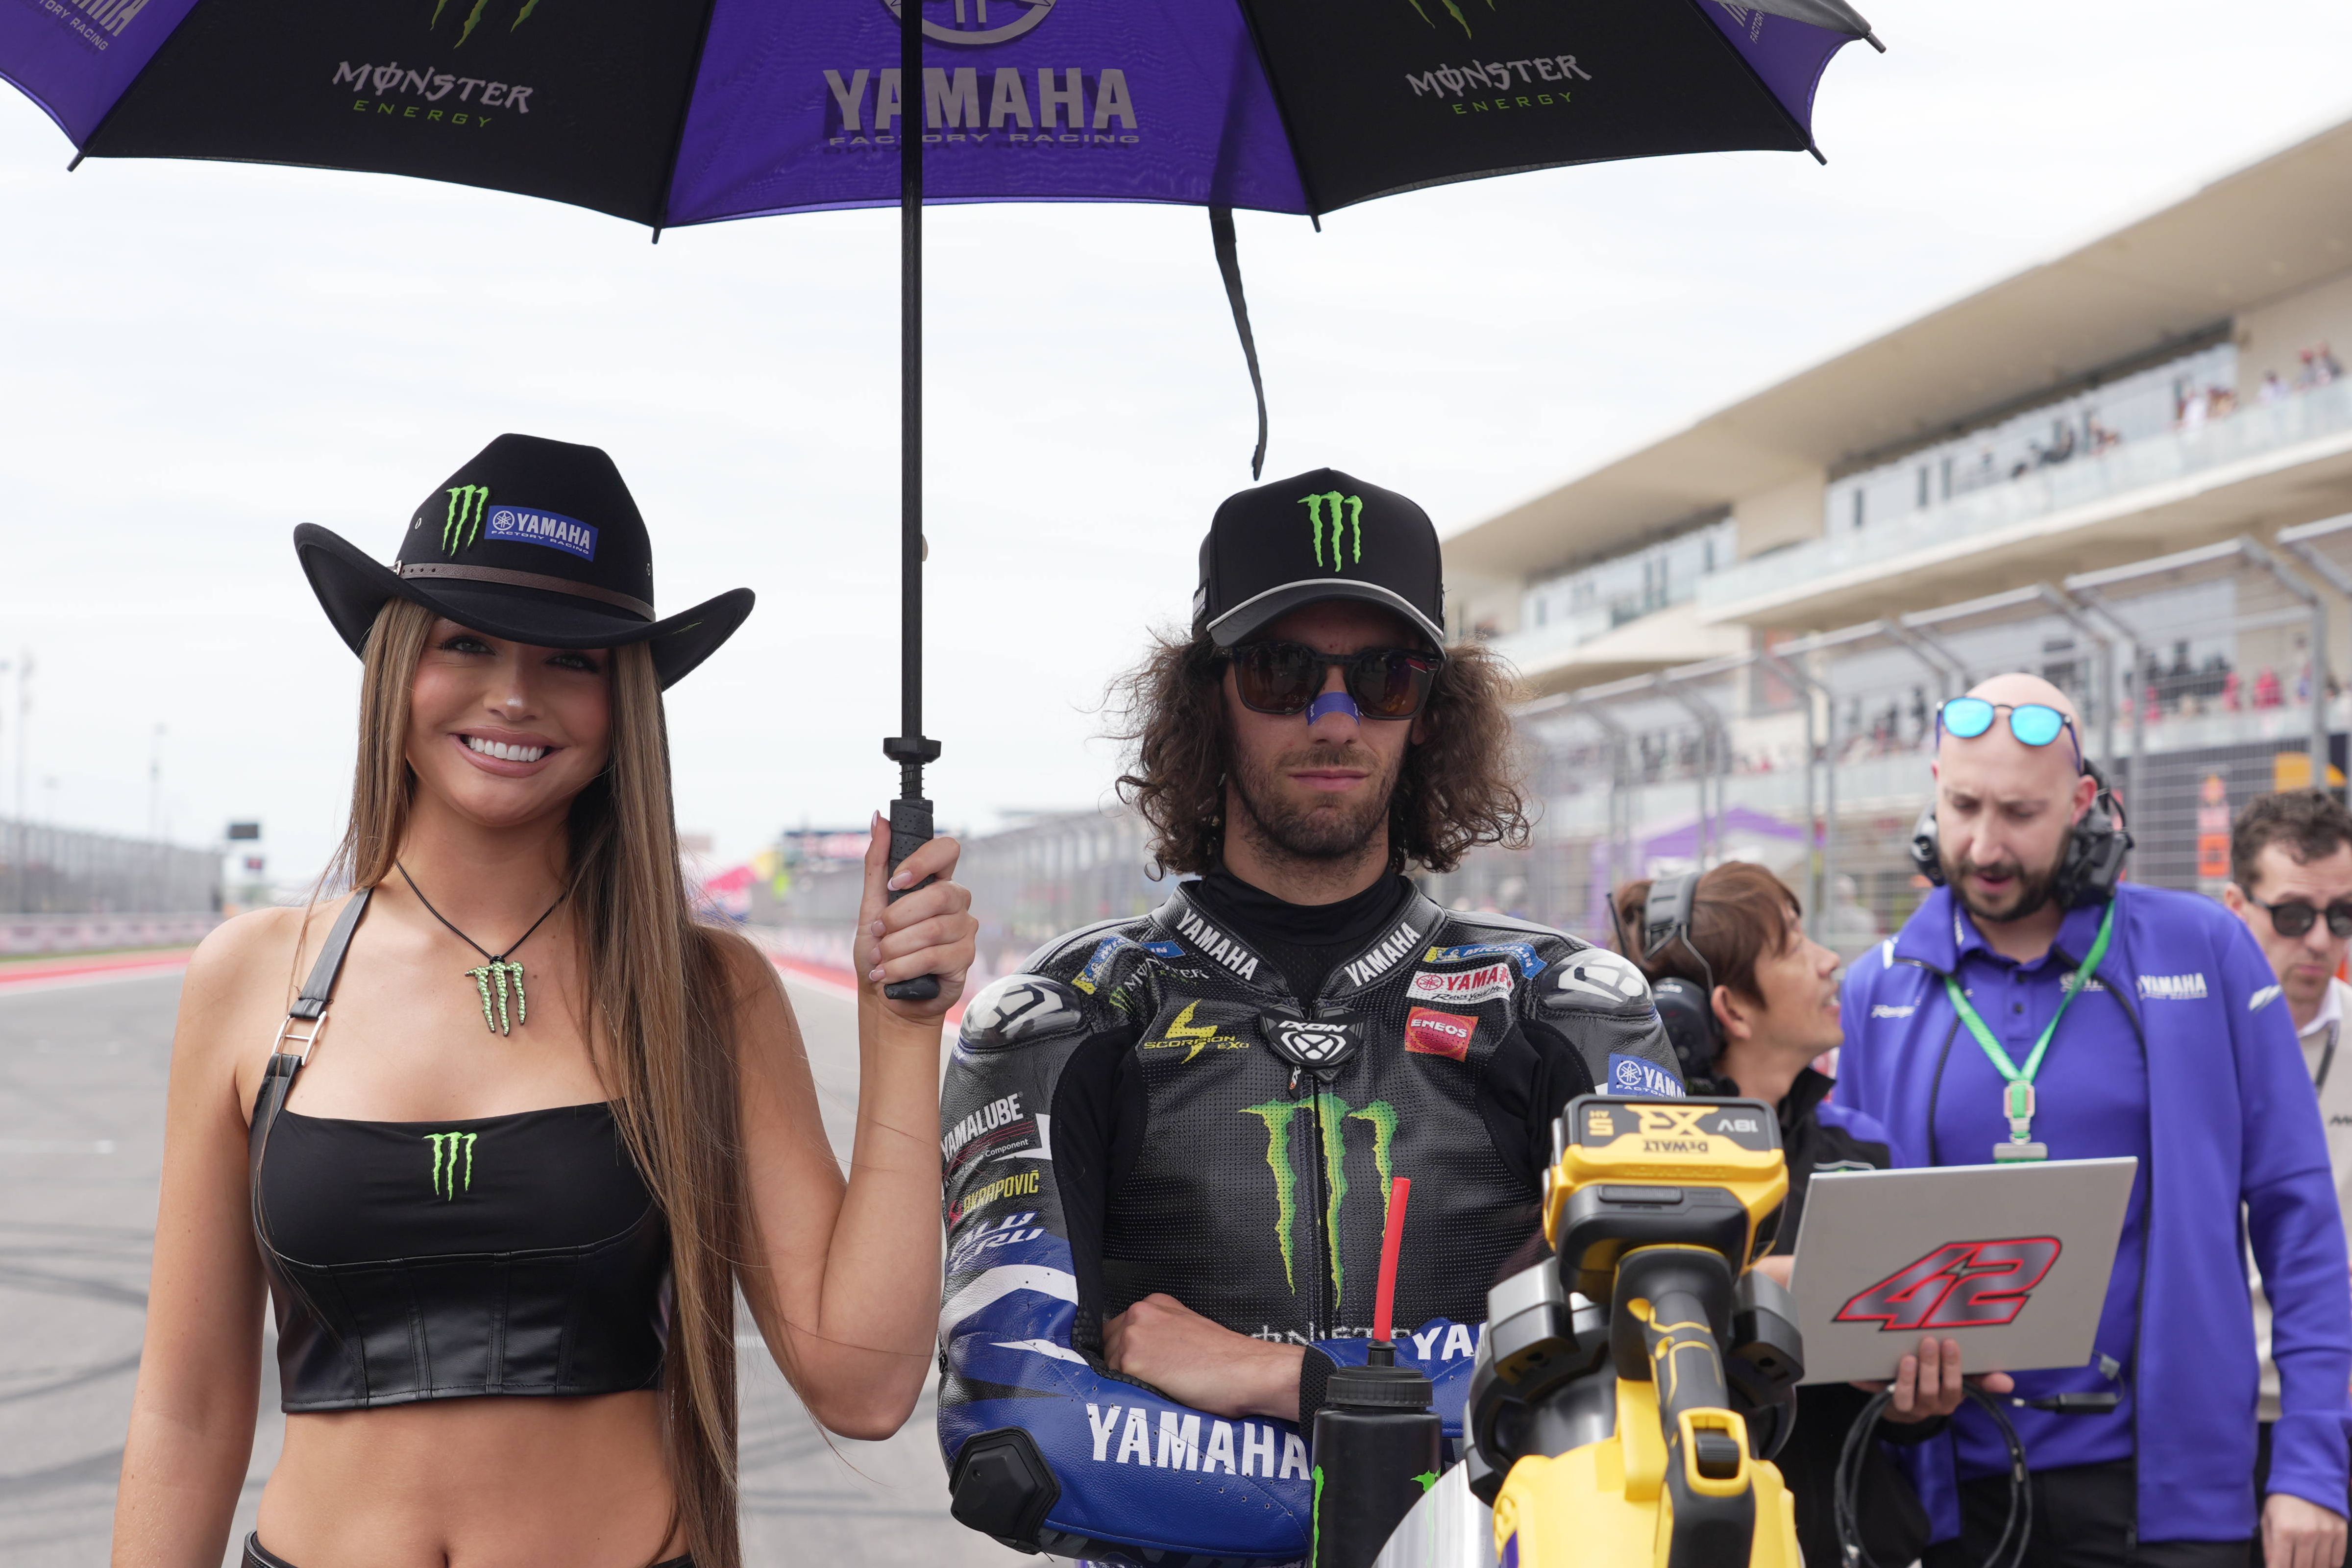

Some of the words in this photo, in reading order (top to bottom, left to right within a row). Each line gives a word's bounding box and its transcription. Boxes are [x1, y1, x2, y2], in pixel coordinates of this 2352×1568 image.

[70, 17, 108, 50] RACING
[353, 99, 491, 127] ENERGY
[823, 68, 1138, 130] YAMAHA
[1452, 92, 1571, 115] ENERGY
[830, 133, 989, 146] FACORY
[1009, 133, 1139, 143] RACING
[491, 531, 544, 539] FACTORY
[550, 539, 589, 554] RACING
[517, 513, 590, 549] YAMAHA
[1176, 908, 1259, 980] YAMAHA
[1344, 922, 1421, 987] YAMAHA
[1278, 1021, 1348, 1032] IXON
[1411, 1019, 1467, 1038] ENEOS
[1143, 1036, 1235, 1050] SCORPION
[940, 1093, 1024, 1163] YAMALUBE
[1589, 1118, 1614, 1136] 5
[1717, 1119, 1759, 1132] 18V
[985, 1139, 1029, 1158] Component
[1832, 1235, 2061, 1332] 42
[1086, 1403, 1311, 1481] YAMAHA
